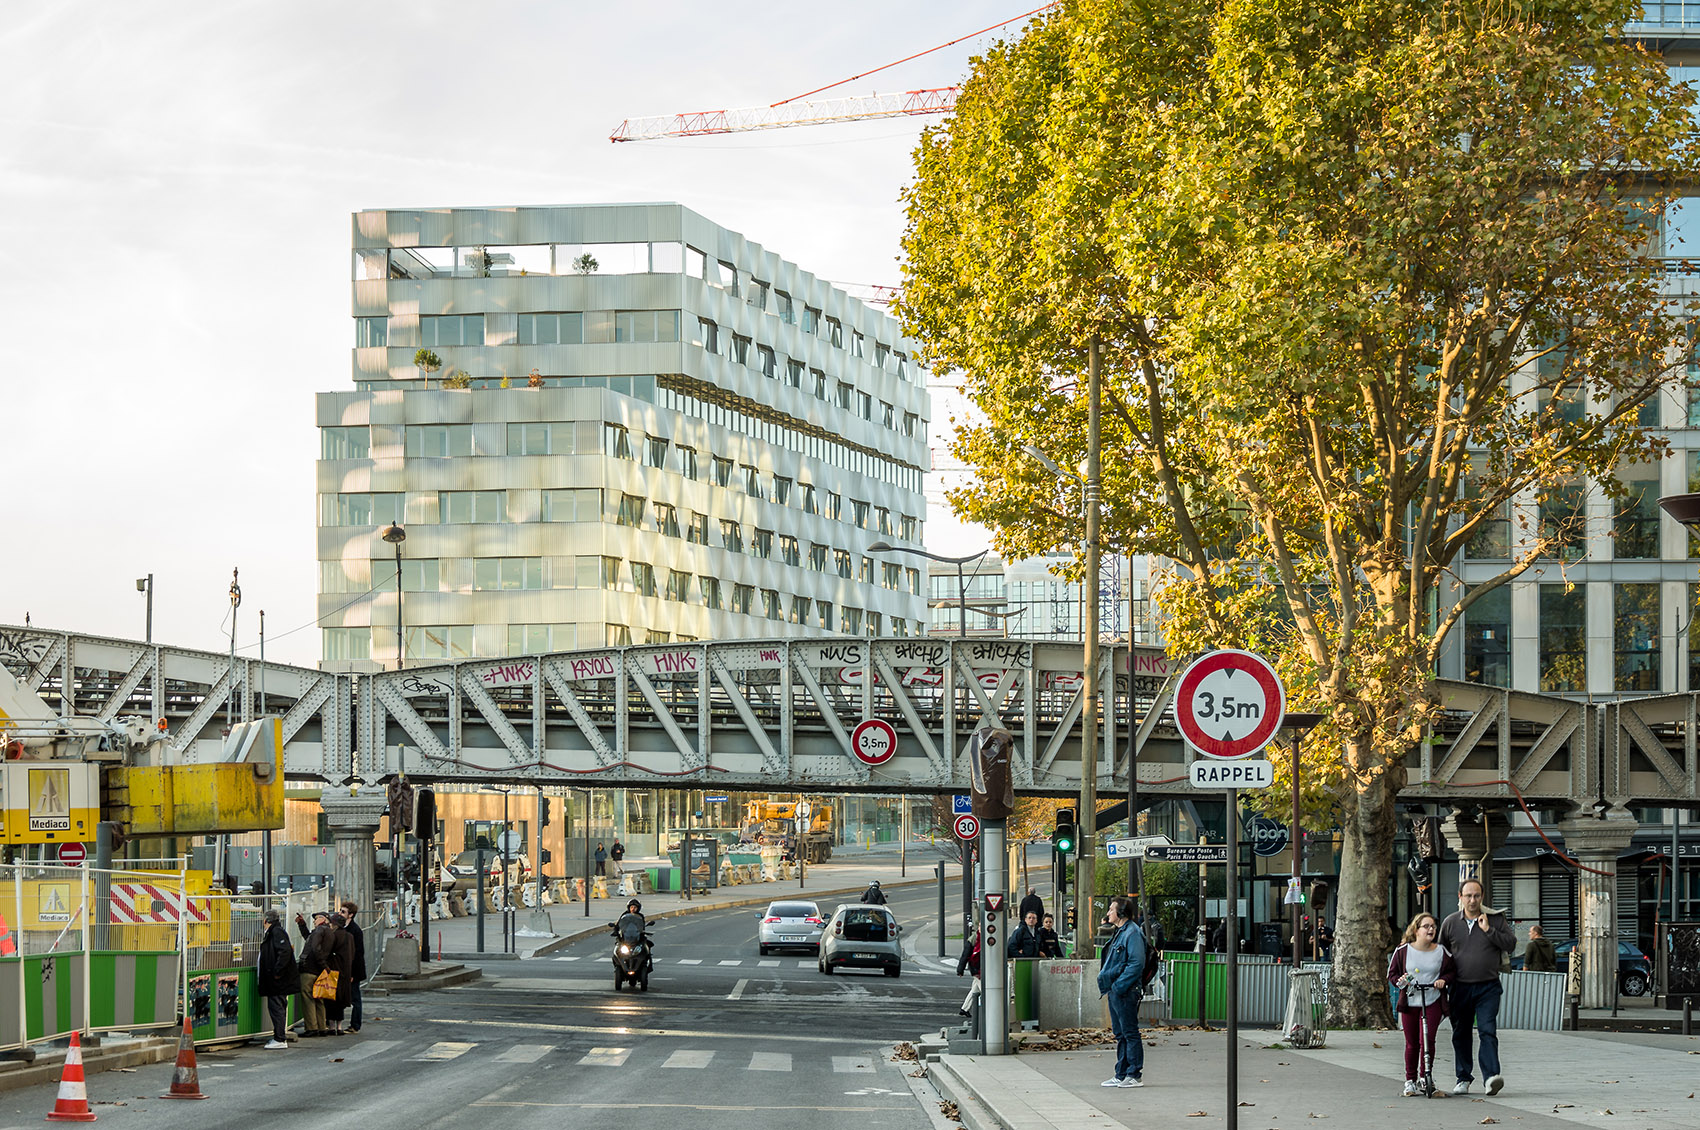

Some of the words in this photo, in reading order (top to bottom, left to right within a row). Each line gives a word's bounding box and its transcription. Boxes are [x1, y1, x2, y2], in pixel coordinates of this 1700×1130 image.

[1197, 691, 1260, 723] 3,5m
[861, 736, 888, 749] 3,5m
[1197, 767, 1265, 782] RAPPEL
[31, 819, 69, 829] Mediaco
[960, 821, 975, 833] 30
